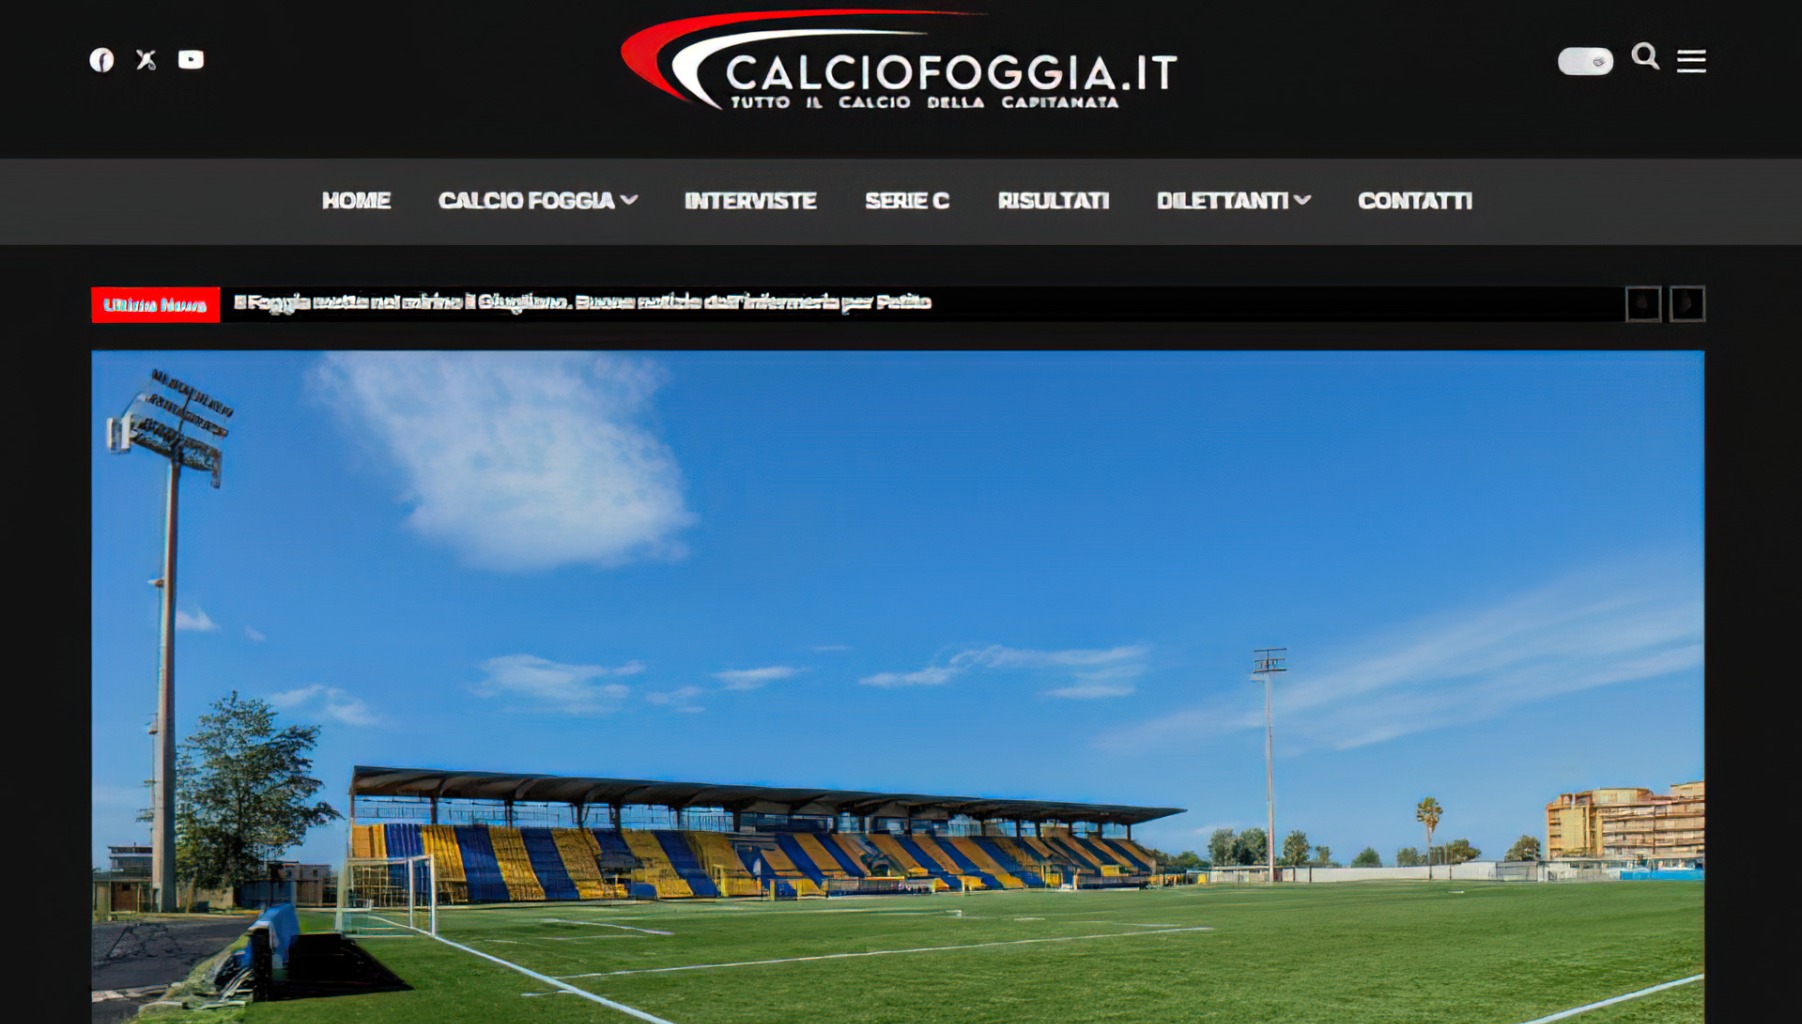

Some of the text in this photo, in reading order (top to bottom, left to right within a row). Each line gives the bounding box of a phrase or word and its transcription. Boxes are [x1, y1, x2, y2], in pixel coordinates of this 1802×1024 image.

[727, 55, 1177, 90] CALCIOFOGGIA.IT
[731, 96, 1119, 108] TUTTO IL CALCIO DELLA CAPITANATA
[323, 191, 391, 209] HOME
[438, 191, 615, 209] CALCIO FOGGIA
[685, 191, 817, 209] INTERVISTE
[866, 191, 949, 209] SERIE C
[999, 191, 1109, 209] RISULTATI
[1158, 191, 1288, 209] DILETTANTI
[1358, 191, 1472, 209] CONTATTI
